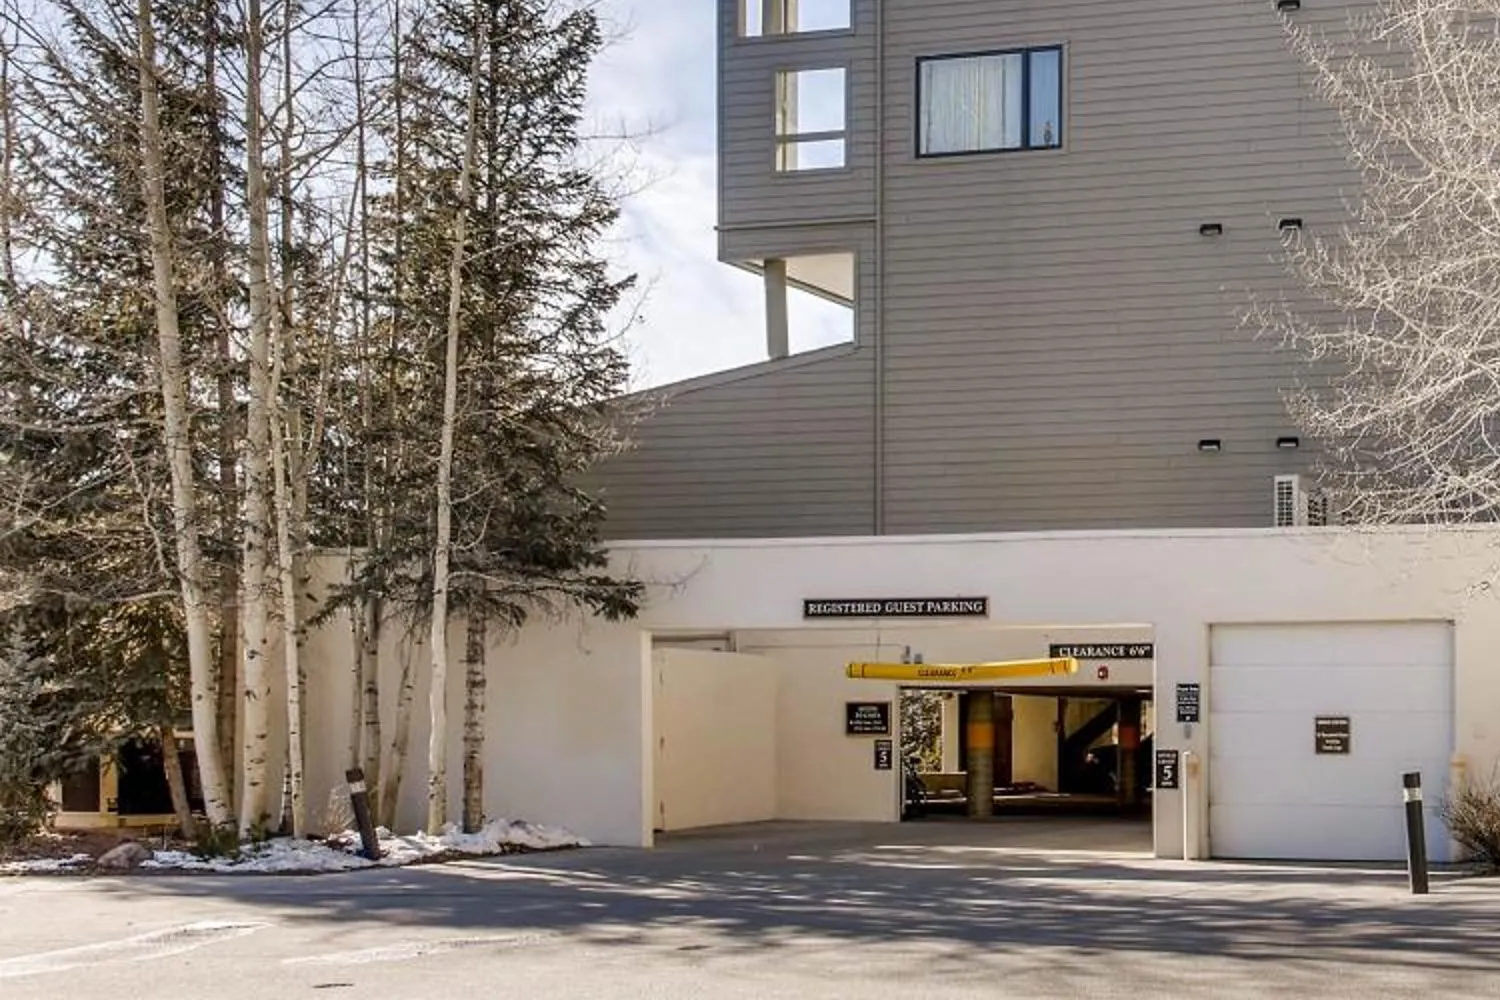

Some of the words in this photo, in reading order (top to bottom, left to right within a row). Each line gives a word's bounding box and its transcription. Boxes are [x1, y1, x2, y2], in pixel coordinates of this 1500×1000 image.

[808, 602, 882, 614] REGISTERED
[885, 601, 925, 613] GUEST
[927, 601, 983, 613] PARKING
[1059, 645, 1126, 657] CLEARANCE
[1163, 765, 1173, 781] 5
